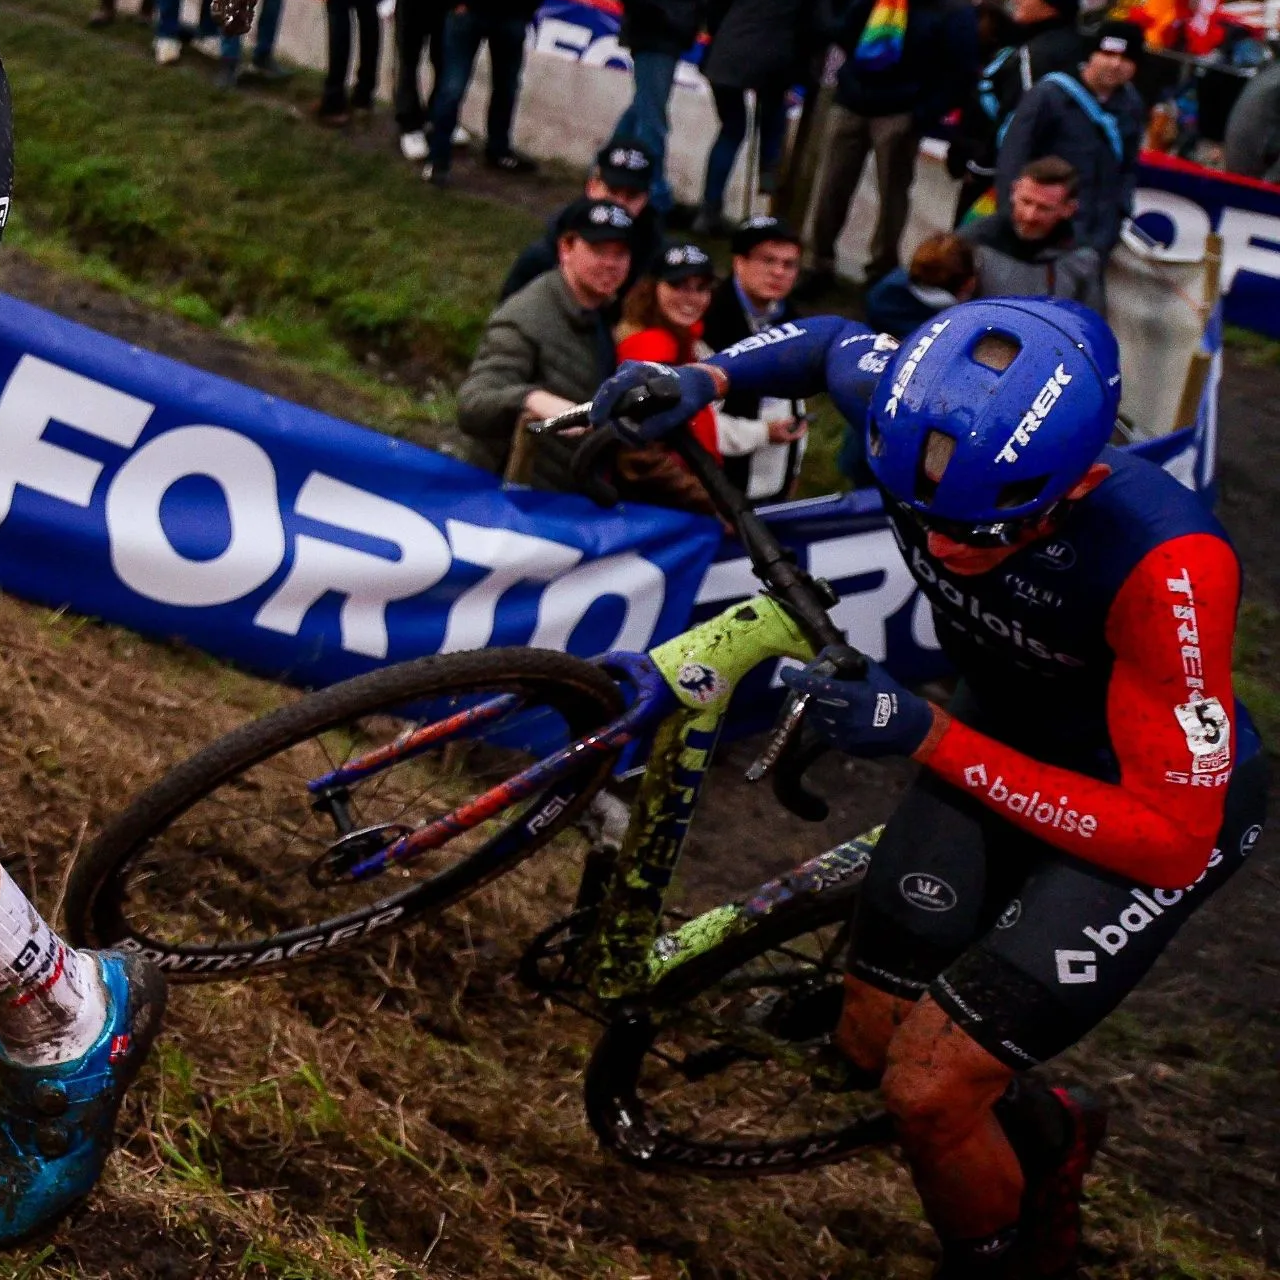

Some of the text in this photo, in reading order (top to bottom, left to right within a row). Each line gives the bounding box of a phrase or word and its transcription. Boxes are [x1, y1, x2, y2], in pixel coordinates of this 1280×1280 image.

[884, 319, 951, 420] TREK
[994, 362, 1073, 464] TREK
[527, 793, 576, 836] RSL
[986, 775, 1098, 838] baloise
